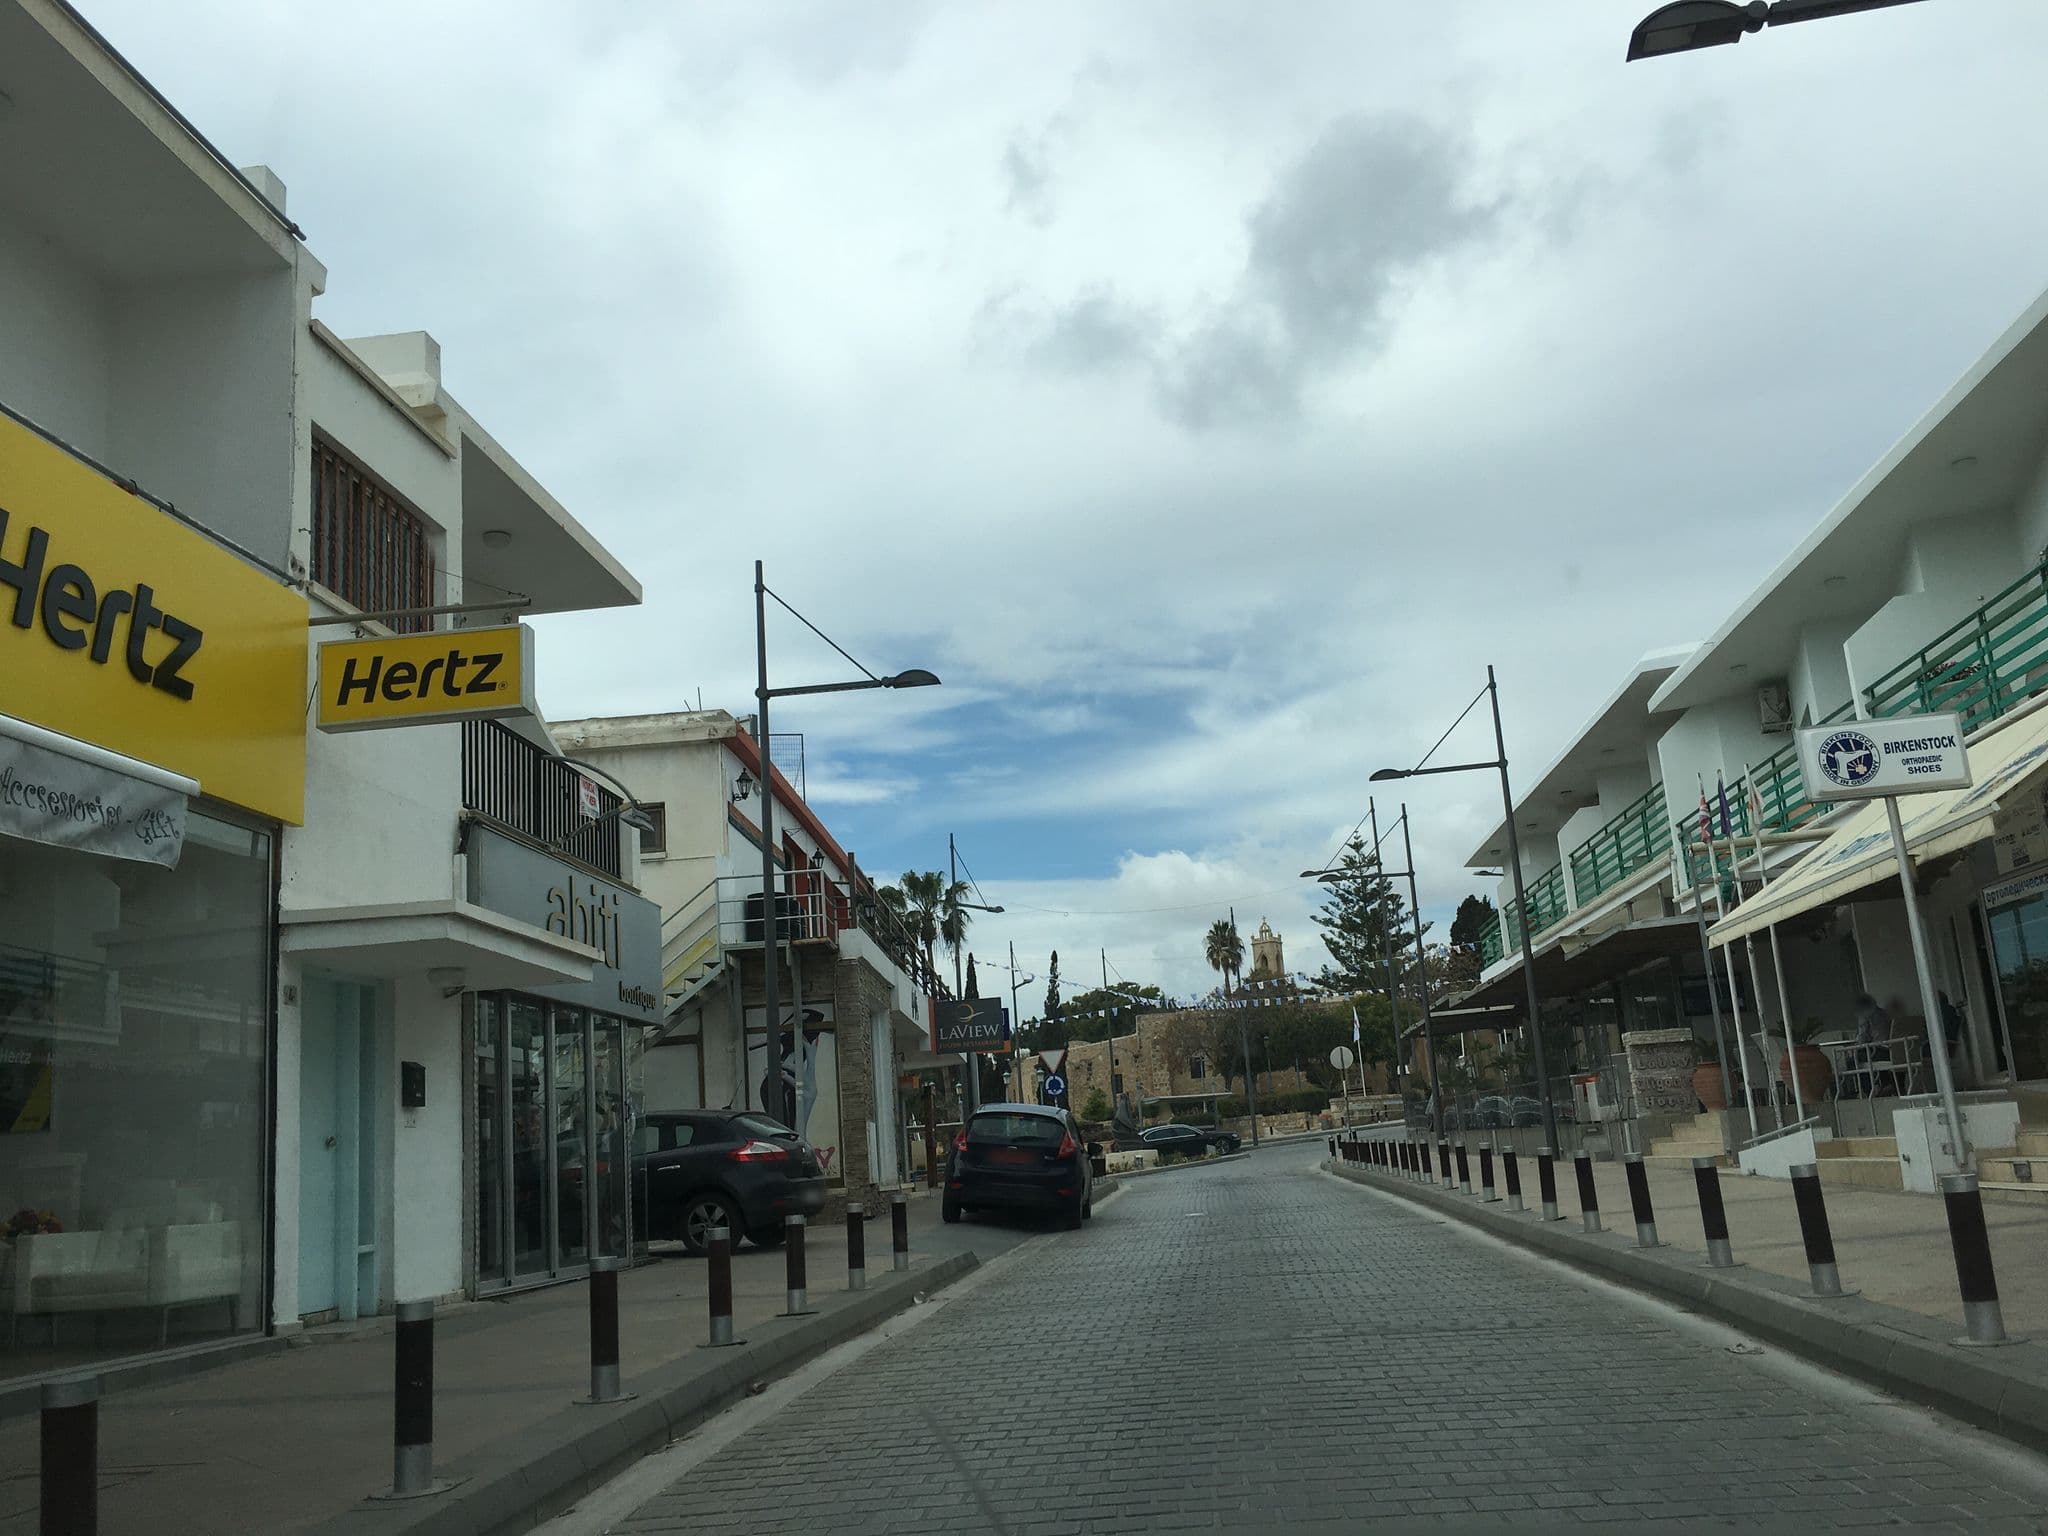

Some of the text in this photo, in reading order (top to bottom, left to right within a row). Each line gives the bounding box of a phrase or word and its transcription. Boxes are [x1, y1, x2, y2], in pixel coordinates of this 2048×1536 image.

[0, 507, 203, 701] Hertz
[337, 650, 504, 706] Hertz
[1821, 732, 1874, 755] BIRKENSTOCK
[1883, 735, 1957, 755] BIRKENSTOCK
[1822, 763, 1839, 781] MADE
[1850, 759, 1879, 785] GERMANY
[1901, 755, 1943, 766] ORTHOPAEDIC
[1907, 764, 1942, 775] SHOES
[618, 980, 656, 1012] boutique
